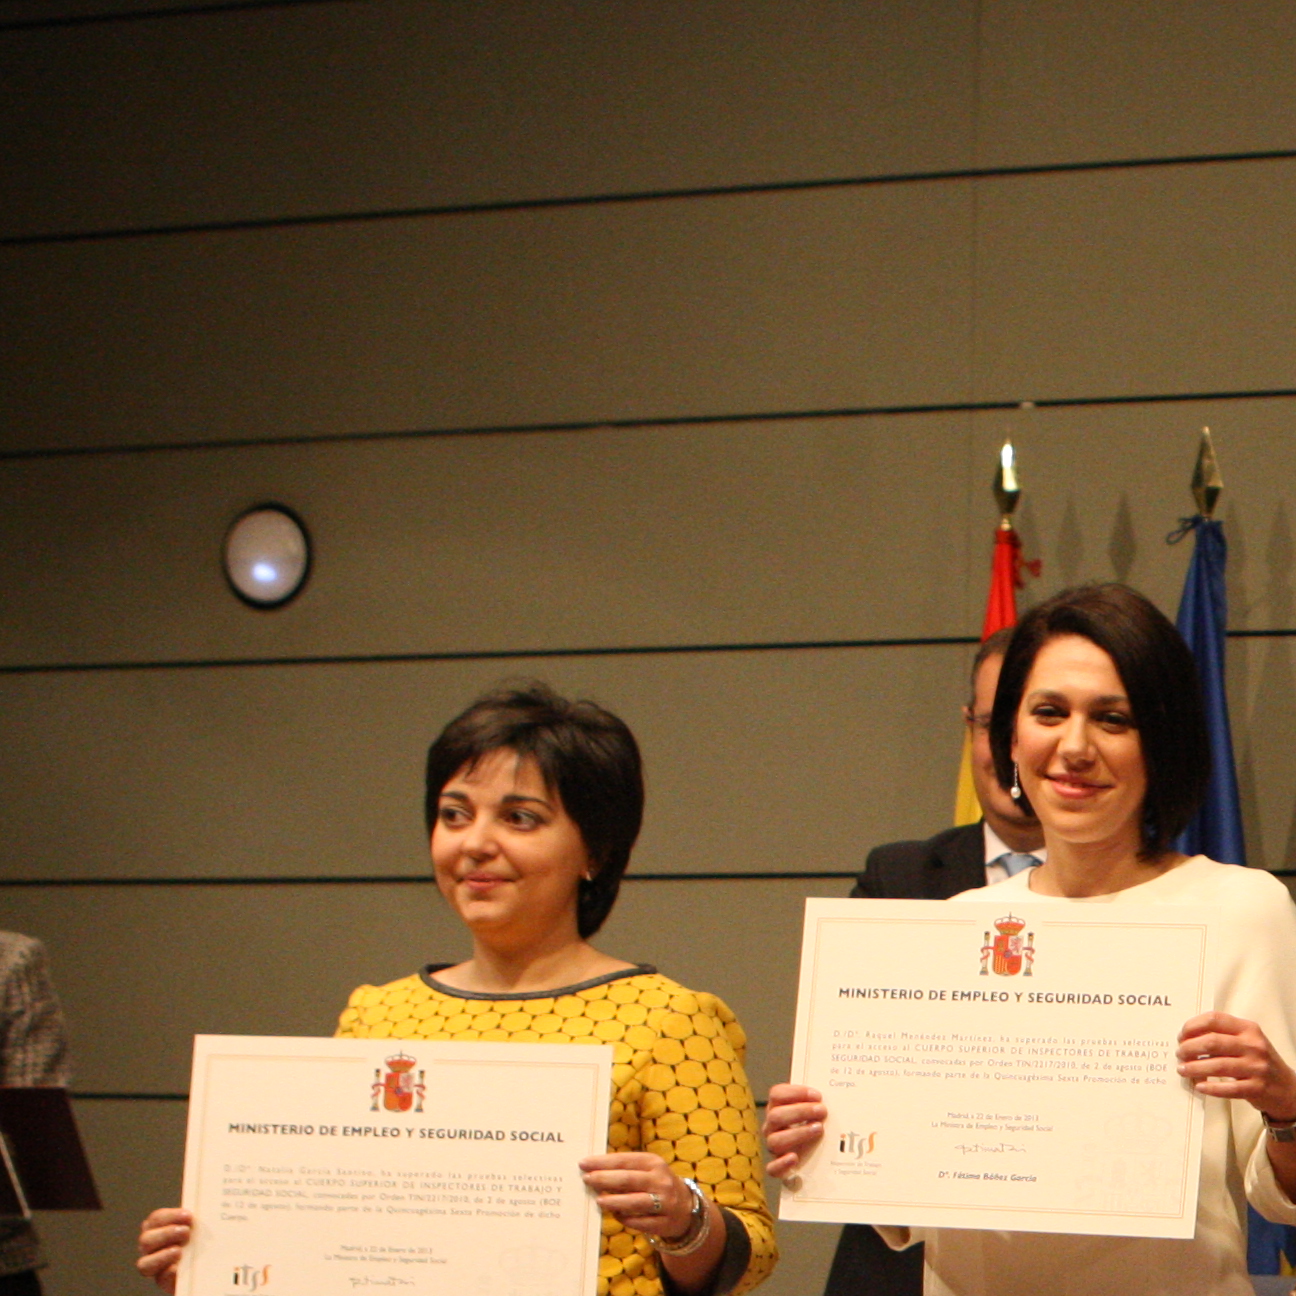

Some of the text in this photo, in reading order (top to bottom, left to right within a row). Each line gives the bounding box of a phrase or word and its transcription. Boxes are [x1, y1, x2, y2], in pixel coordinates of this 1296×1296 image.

[838, 988, 1171, 1006] MINISTERIO DE EMPLEO Y SEGURIDAD SOCIAL
[228, 1123, 564, 1142] MINISTERIO DE EMPLEO Y SEGURIDAD SOCIAL
